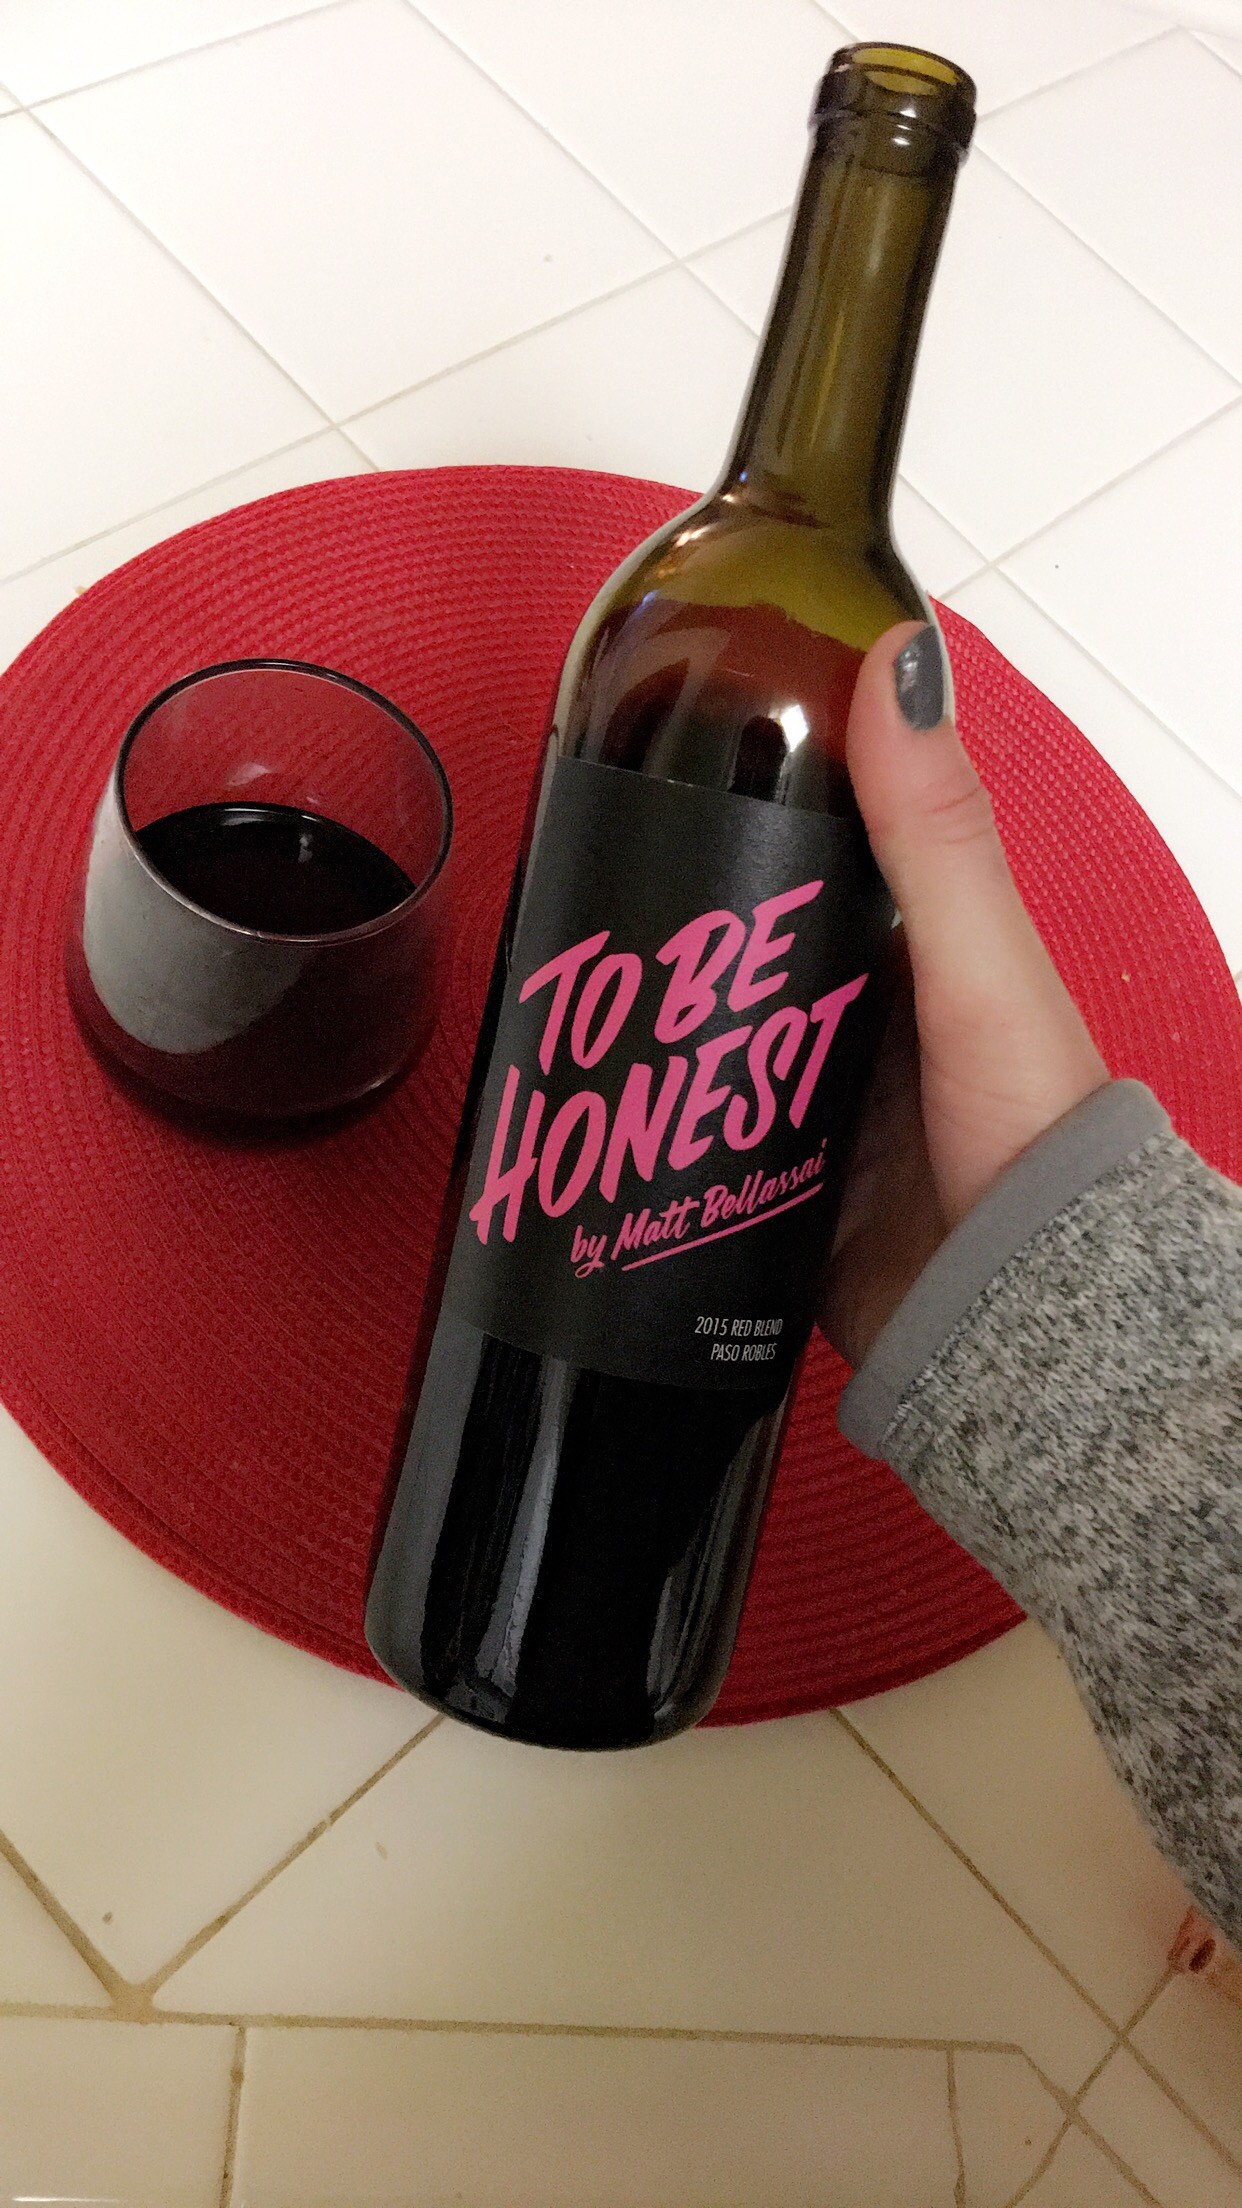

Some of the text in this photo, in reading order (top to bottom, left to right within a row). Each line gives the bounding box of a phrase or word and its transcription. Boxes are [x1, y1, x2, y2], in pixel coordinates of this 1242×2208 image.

[518, 880, 824, 1075] TO BE
[469, 974, 868, 1245] HONEST
[570, 1138, 828, 1279] by Matt Bellassai
[694, 1316, 783, 1337] 2015 RED BLEND
[710, 1342, 777, 1361] PASO ROBLES
